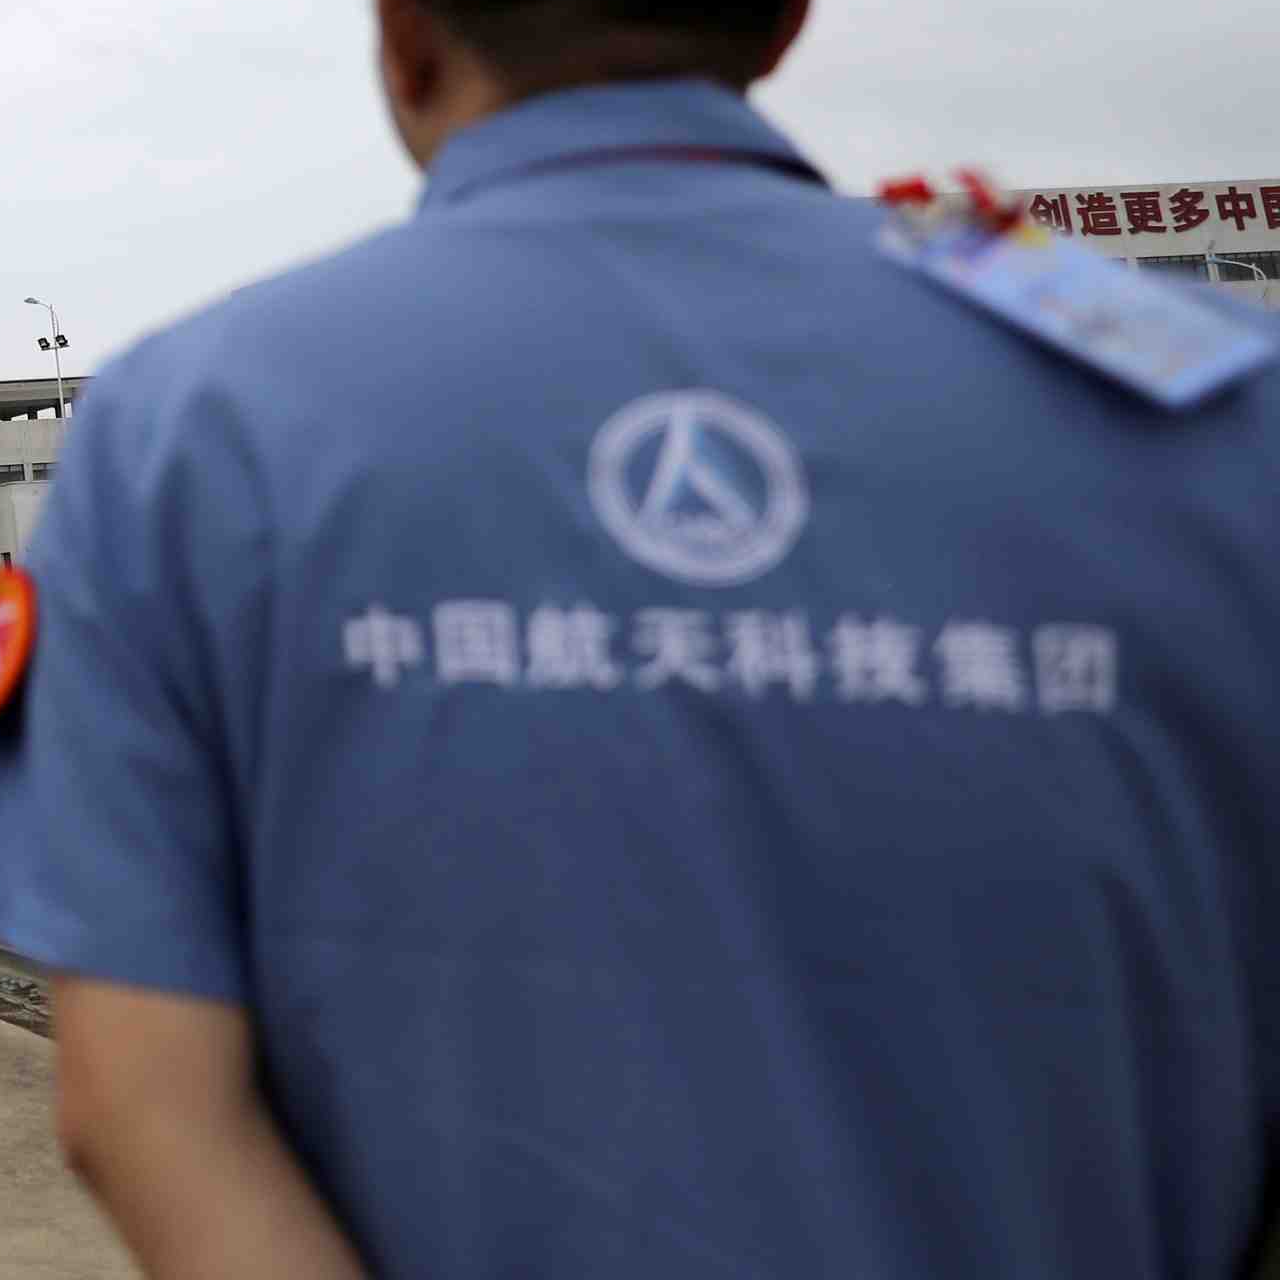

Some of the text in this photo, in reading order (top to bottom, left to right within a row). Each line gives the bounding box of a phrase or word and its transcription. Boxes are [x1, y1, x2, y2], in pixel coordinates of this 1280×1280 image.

[342, 601, 1120, 713] 中国航天科技集团
